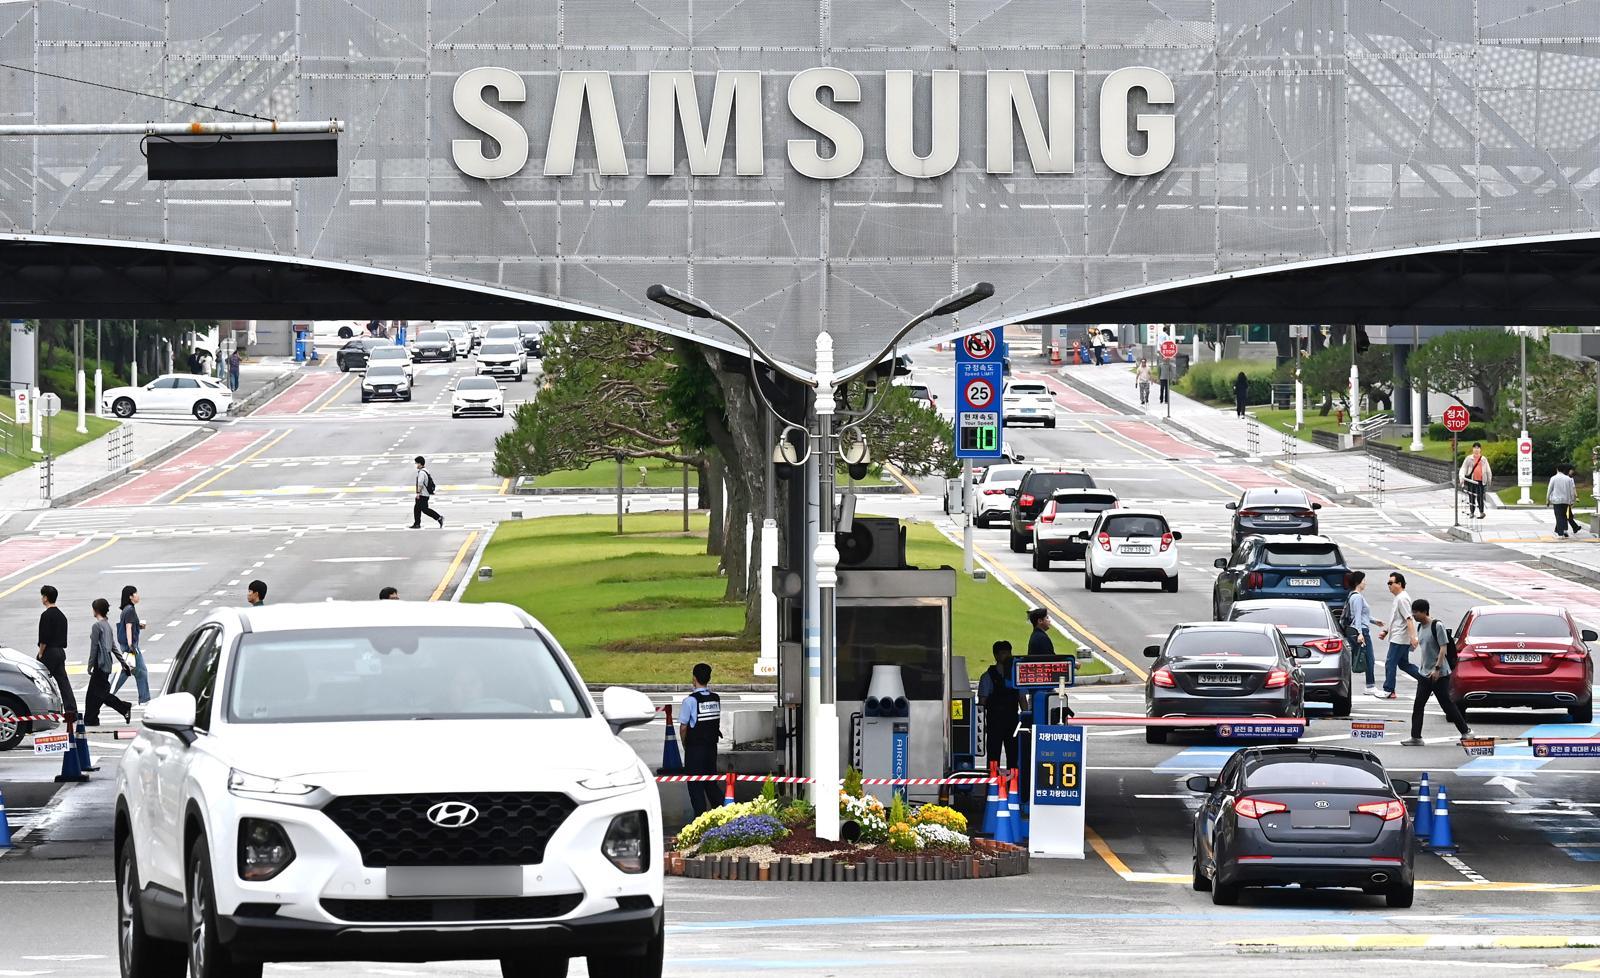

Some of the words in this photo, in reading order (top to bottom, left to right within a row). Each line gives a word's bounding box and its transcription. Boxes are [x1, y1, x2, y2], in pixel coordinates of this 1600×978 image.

[452, 66, 1176, 179] SAMSUNG
[964, 364, 994, 372] 규정속도
[970, 386, 989, 400] 25
[964, 413, 994, 421] 현재속도
[1447, 410, 1465, 419] 정지
[1447, 420, 1466, 428] STOP
[1219, 674, 1238, 683] 0244
[1360, 730, 1384, 738] 진입금지
[44, 742, 68, 751] 진입금지
[1042, 763, 1054, 785] 7
[1062, 763, 1077, 787] 8
[1036, 789, 1048, 797] 번호
